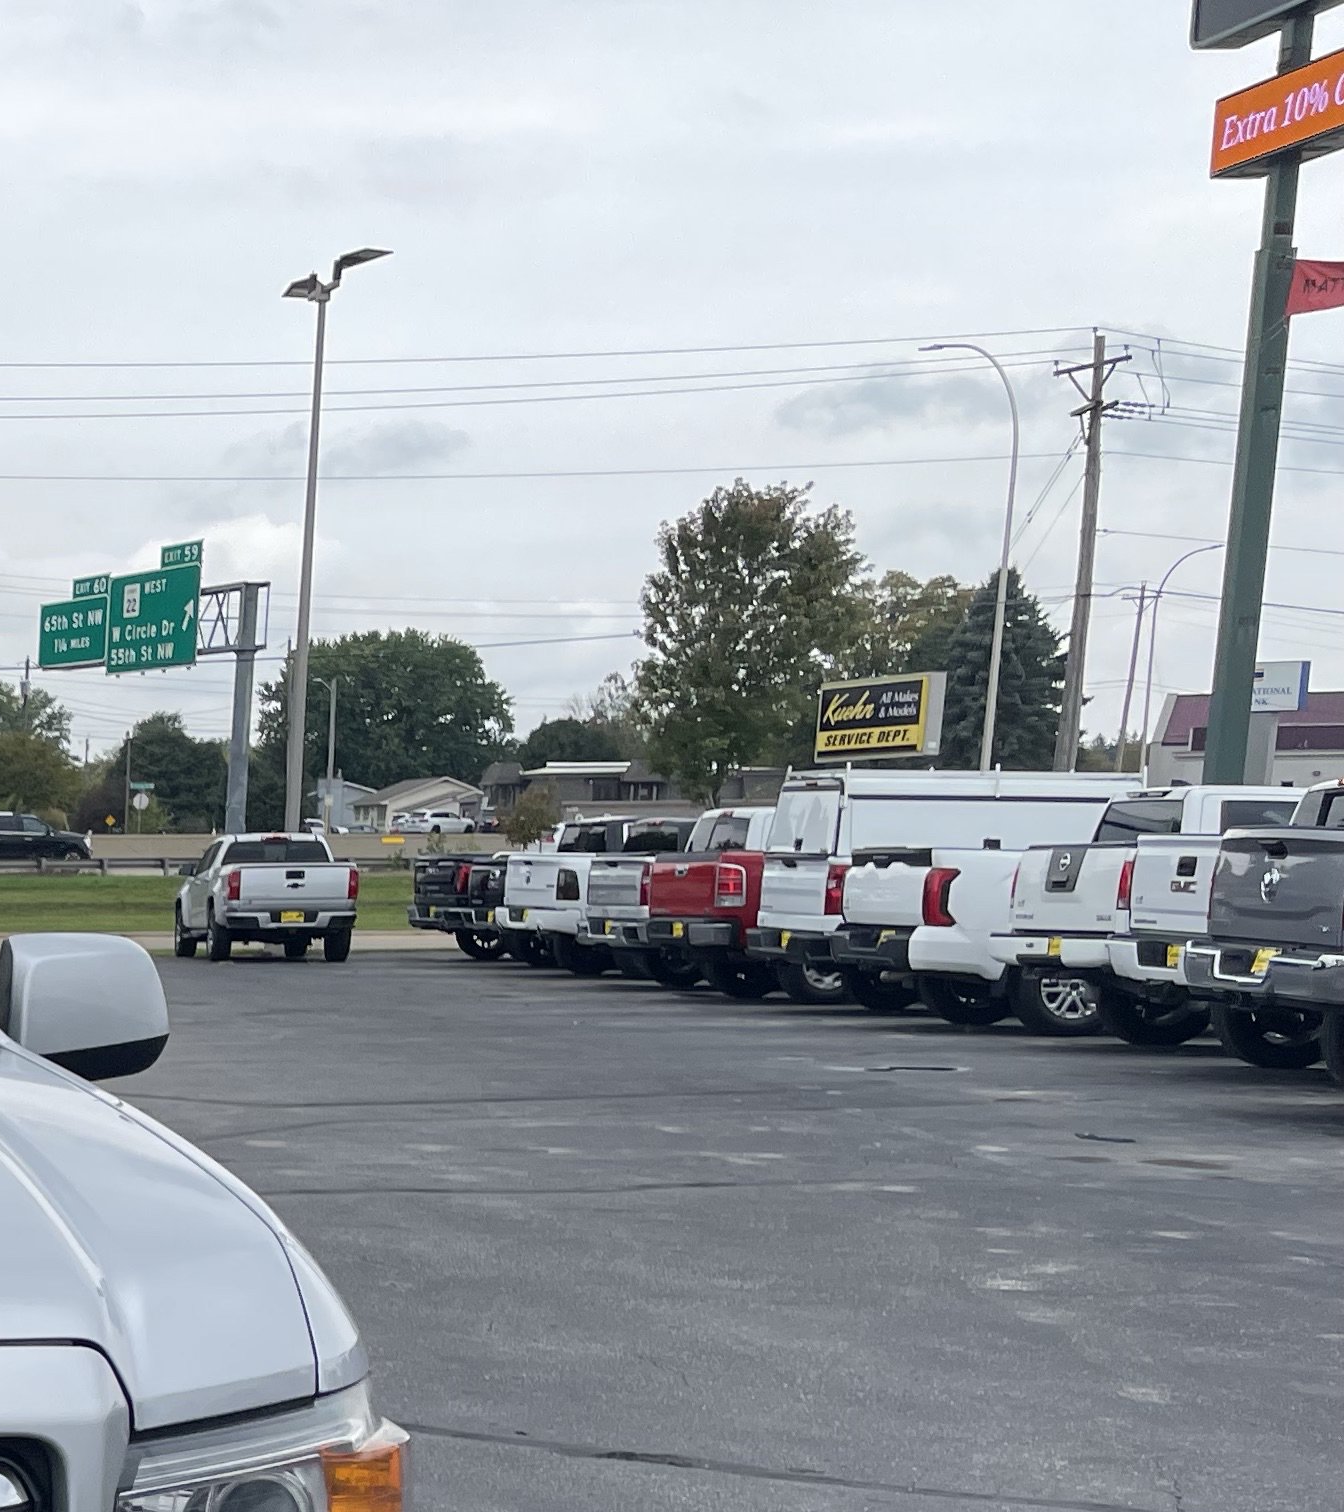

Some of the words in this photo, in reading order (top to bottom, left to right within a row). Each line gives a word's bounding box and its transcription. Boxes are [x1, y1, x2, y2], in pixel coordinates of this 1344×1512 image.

[1220, 106, 1278, 151] Extra
[1281, 80, 1329, 128] 10%
[164, 550, 181, 563] EXIT
[184, 545, 199, 562] 59
[75, 582, 90, 595] EXIT
[93, 578, 107, 593] 60
[144, 579, 167, 594] WEST
[126, 598, 137, 613] 22
[44, 614, 68, 632] 65th
[72, 612, 83, 629] St
[88, 609, 103, 626] NW
[112, 627, 120, 642] W
[125, 622, 157, 641] Circle
[162, 620, 175, 636] Dr
[111, 647, 135, 666] 55th
[141, 645, 152, 661] St
[157, 642, 174, 659] NW
[1252, 687, 1292, 696] ATIONAL
[823, 690, 874, 726] Kuehn
[824, 731, 873, 747] SERVICE
[877, 729, 910, 744] DEPT.
